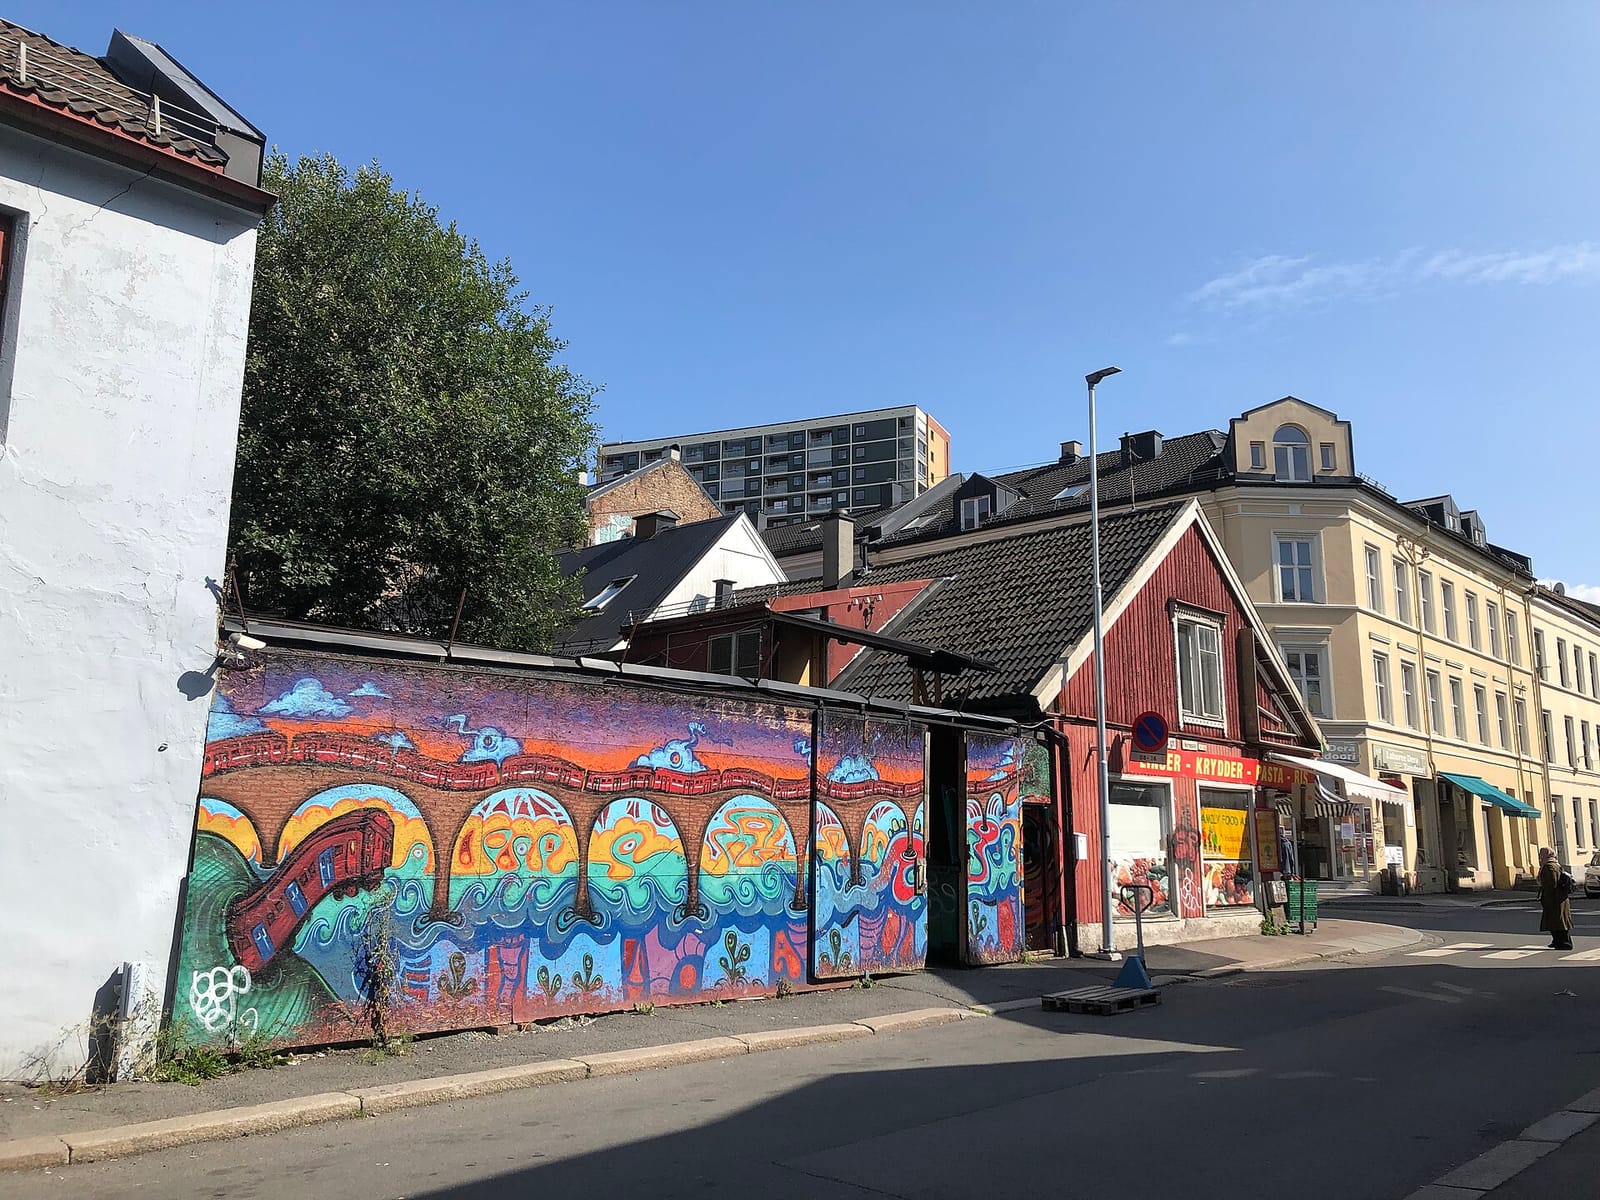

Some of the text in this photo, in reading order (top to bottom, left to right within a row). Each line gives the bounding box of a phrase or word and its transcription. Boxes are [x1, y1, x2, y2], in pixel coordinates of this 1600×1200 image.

[1324, 752, 1356, 761] doori
[1196, 757, 1243, 779] KRYDDER
[1256, 764, 1284, 783] PASTA
[1294, 770, 1309, 785] RIS
